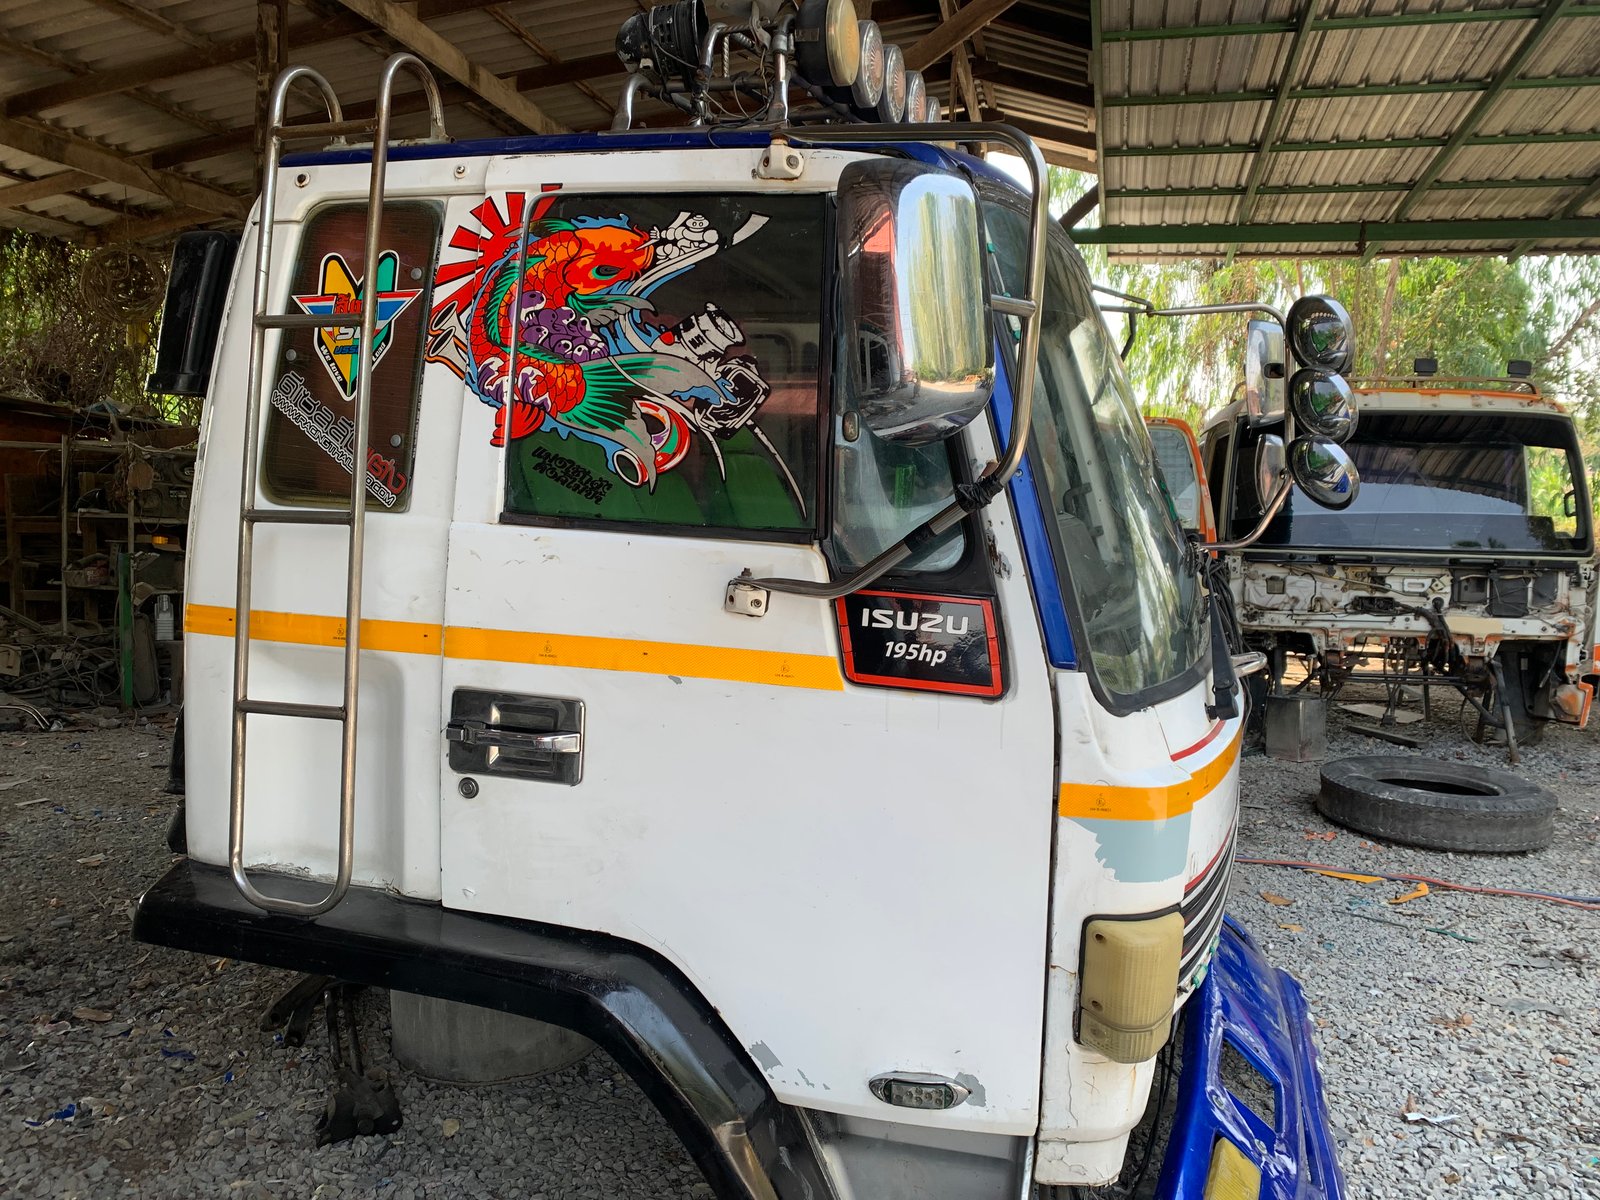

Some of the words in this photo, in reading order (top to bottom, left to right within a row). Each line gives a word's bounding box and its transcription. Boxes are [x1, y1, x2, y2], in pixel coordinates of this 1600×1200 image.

[320, 344, 331, 360] We
[329, 361, 343, 382] love
[272, 391, 396, 507] WWW.RACINGTHAILD.COM
[861, 607, 969, 635] ISUZU
[885, 641, 947, 667] 195hp
